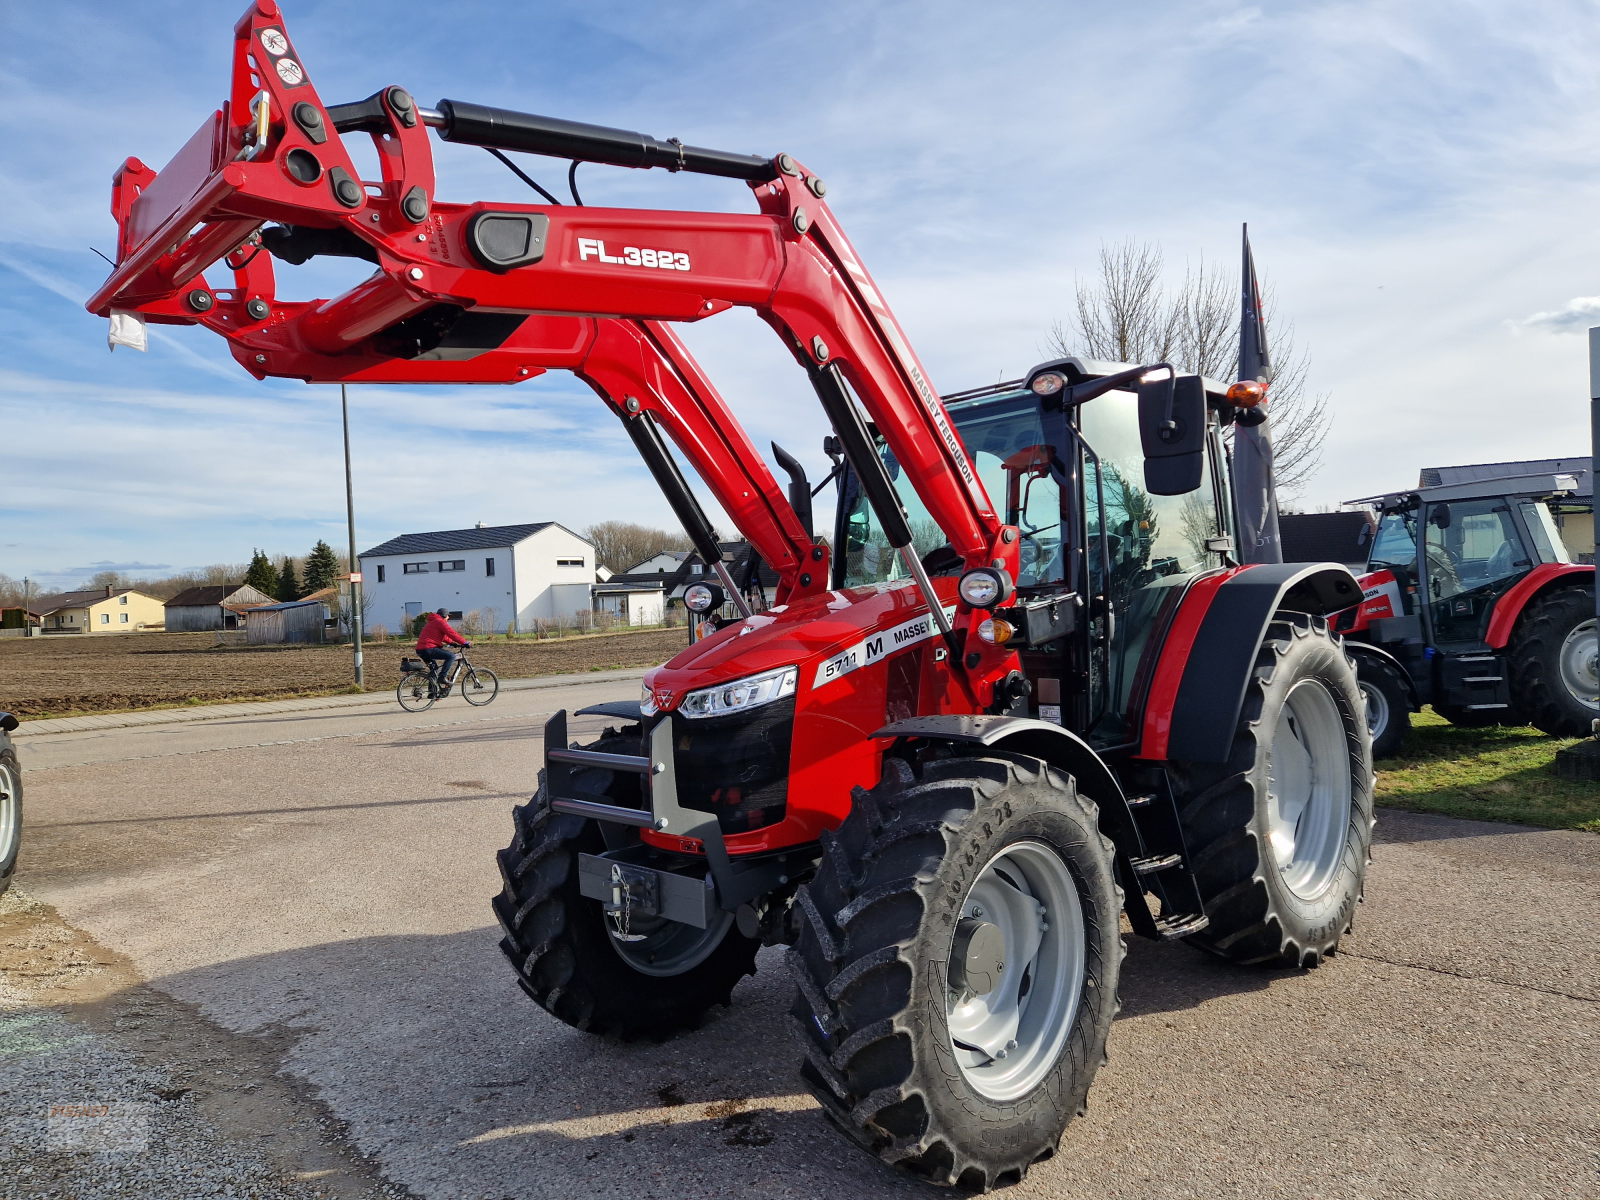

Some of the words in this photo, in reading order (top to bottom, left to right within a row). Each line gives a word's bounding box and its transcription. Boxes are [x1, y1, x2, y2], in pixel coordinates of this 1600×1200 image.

[577, 237, 691, 271] FL.3823
[911, 366, 941, 418] MASSEY
[939, 419, 974, 485] FERGUSON
[825, 651, 857, 677] 5711
[866, 637, 884, 660] M
[893, 620, 931, 645] MASSEY
